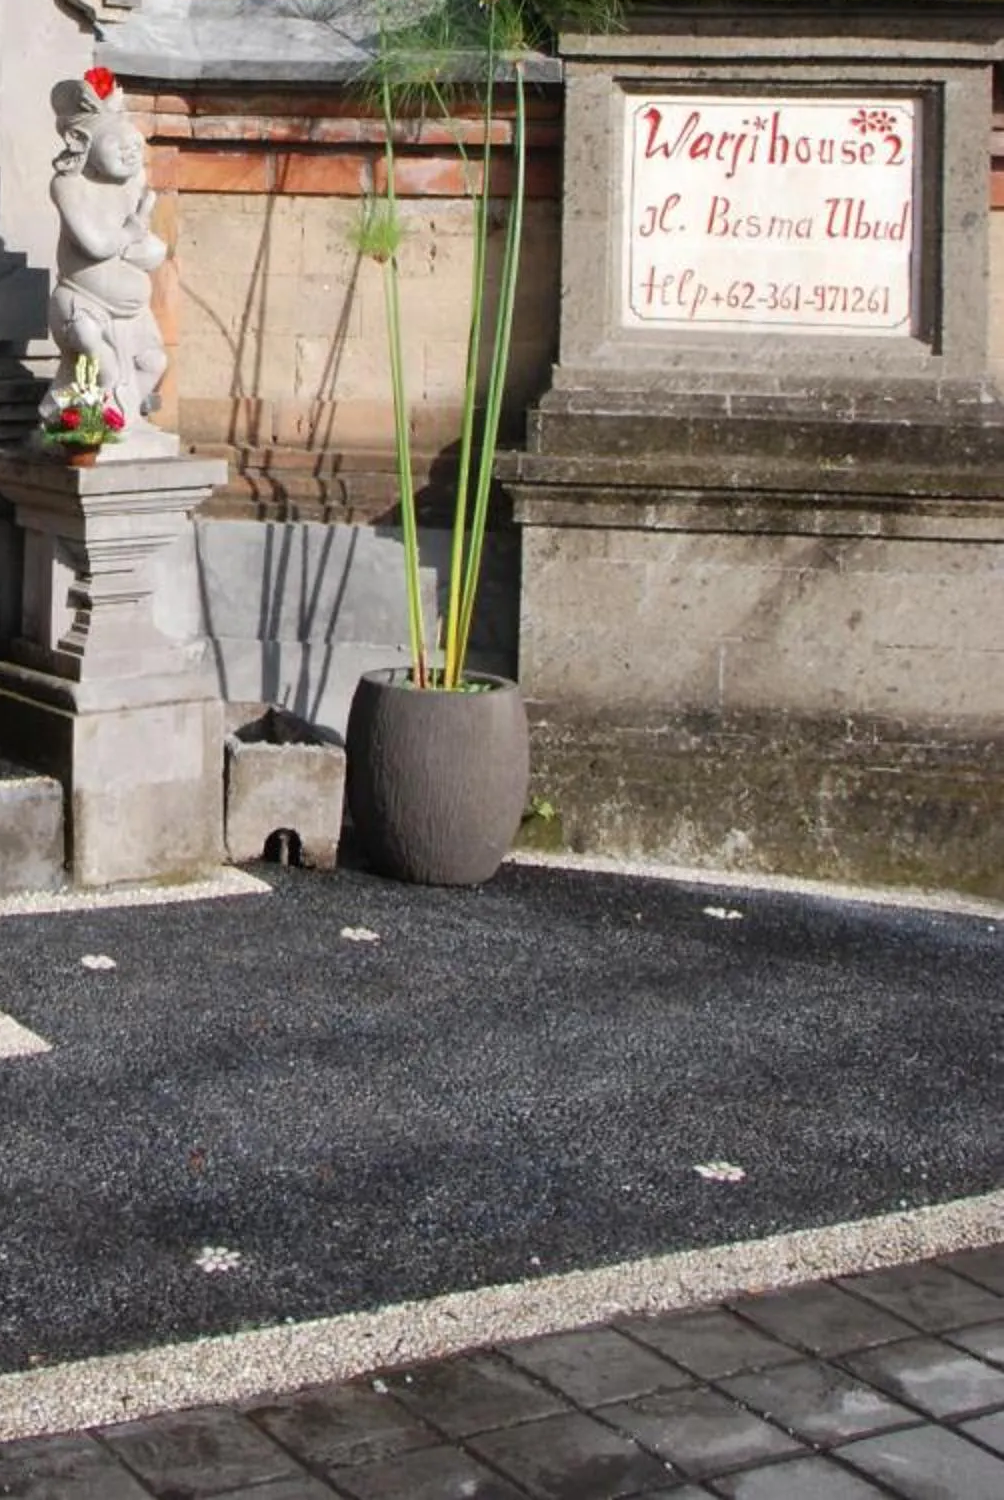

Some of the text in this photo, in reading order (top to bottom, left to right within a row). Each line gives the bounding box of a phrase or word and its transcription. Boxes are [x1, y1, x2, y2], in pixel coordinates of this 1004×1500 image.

[883, 134, 905, 167] 2
[639, 193, 685, 238] Jl.
[825, 197, 911, 242] Ubud
